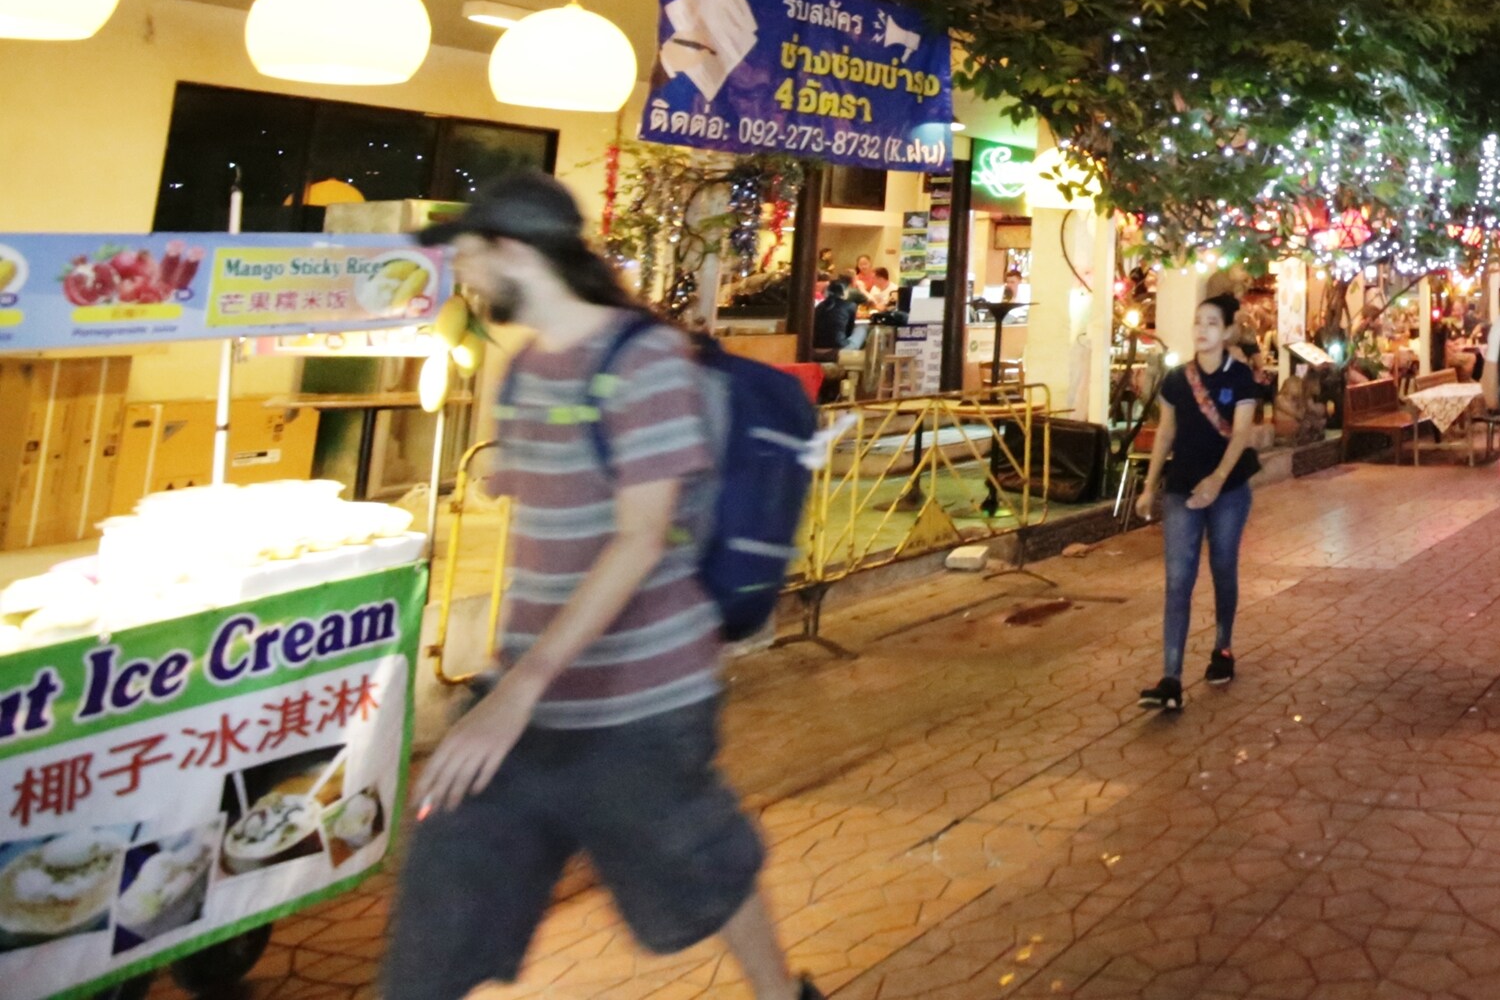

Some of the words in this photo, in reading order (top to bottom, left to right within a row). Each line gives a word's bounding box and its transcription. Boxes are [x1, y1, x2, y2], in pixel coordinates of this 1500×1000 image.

[774, 77, 794, 110] 4
[650, 99, 730, 141] ติดต่อ:
[738, 117, 880, 159] 092-273-8732
[226, 258, 285, 280] Mango
[290, 257, 339, 277] Sticky
[346, 257, 380, 276] Rice
[78, 649, 189, 719] Ice
[209, 601, 396, 682] Cream
[10, 675, 381, 827] 椰子冰淇淋
